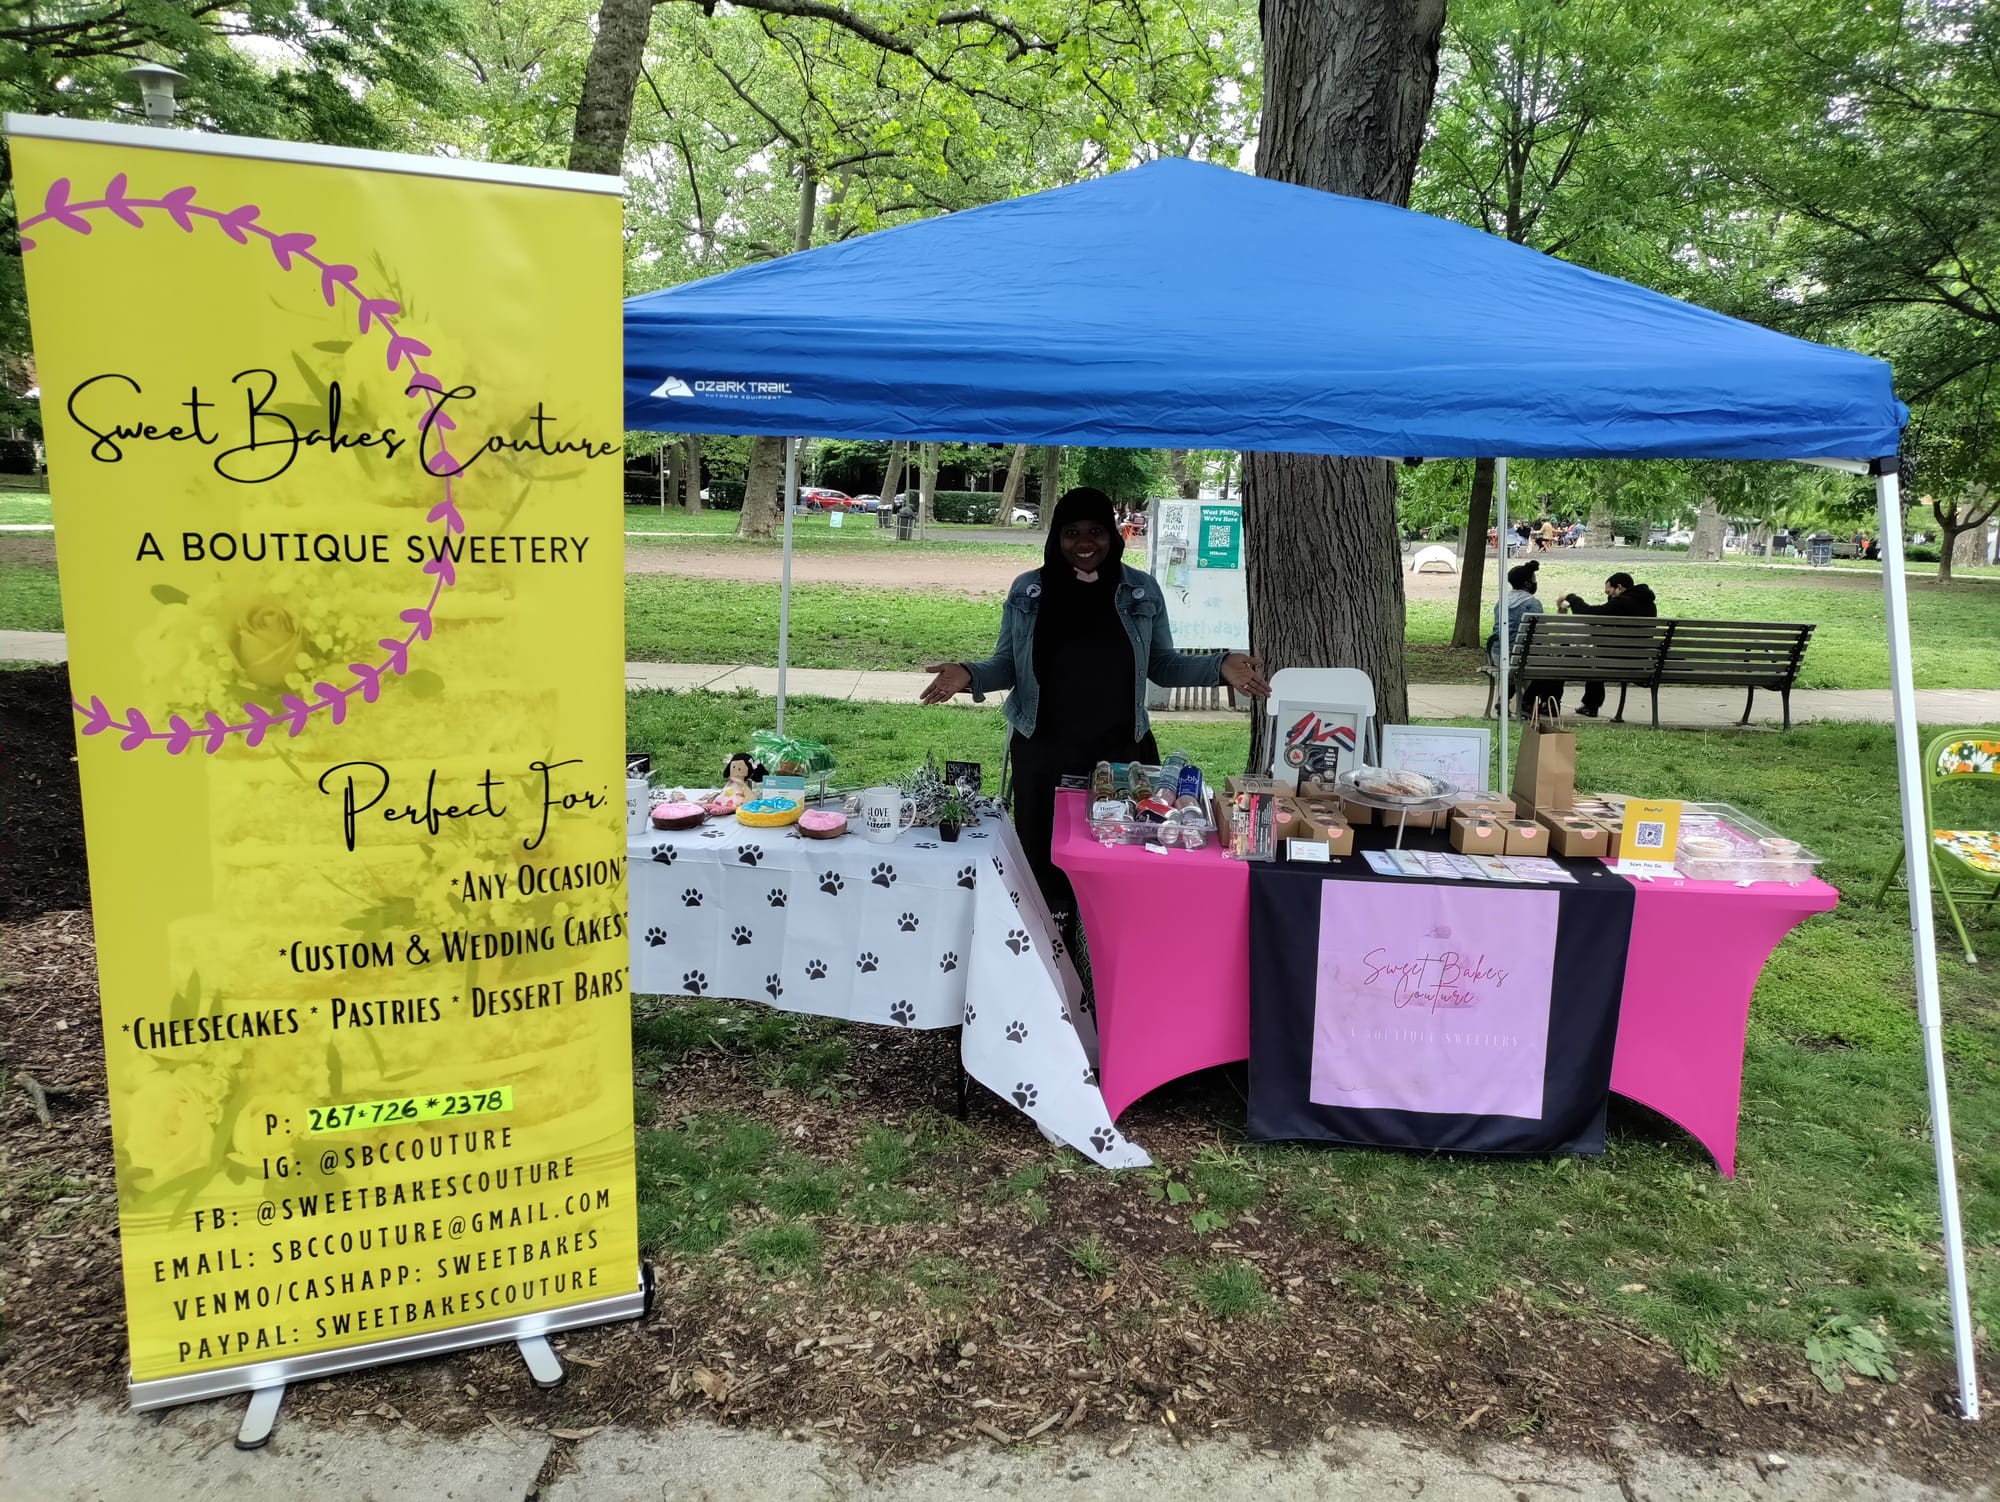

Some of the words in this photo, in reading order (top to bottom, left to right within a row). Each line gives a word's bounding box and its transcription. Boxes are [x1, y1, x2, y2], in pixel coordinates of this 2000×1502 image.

[67, 373, 219, 463] Sweet
[214, 368, 406, 484] Bakes
[404, 384, 622, 477] Couture
[136, 532, 165, 562] A
[182, 532, 390, 563] BOUTIQUE
[407, 535, 589, 564] SWEETERY
[1162, 523, 1185, 531] PLANT
[318, 761, 507, 852] Perfect
[522, 759, 609, 852] For:
[870, 807, 889, 817] LOVE
[406, 934, 431, 966] &
[441, 925, 555, 963] WEDDING
[1362, 947, 1445, 989] Sweet
[1439, 951, 1509, 988] Bakes
[331, 997, 441, 1030] PASTRIES
[471, 980, 564, 1018] DESSERT
[1393, 974, 1475, 1015] Couture
[265, 1111, 293, 1137] P:
[263, 1156, 302, 1181] IG:
[319, 1127, 512, 1176] @SBCCOUTURE
[194, 1207, 239, 1233] FB:
[256, 1156, 574, 1226] @SWEETBAKESCOUTURE
[154, 1248, 255, 1283] EMAIL:
[272, 1188, 610, 1264] SBCCOUTURE@GMAIL.COM
[173, 1265, 422, 1321] VENMO/CASHAPP:
[438, 1229, 598, 1278] SWEETBAKES
[179, 1325, 299, 1363] PAYPAL:
[316, 1267, 598, 1338] SWEETBAKESCOUTURE
